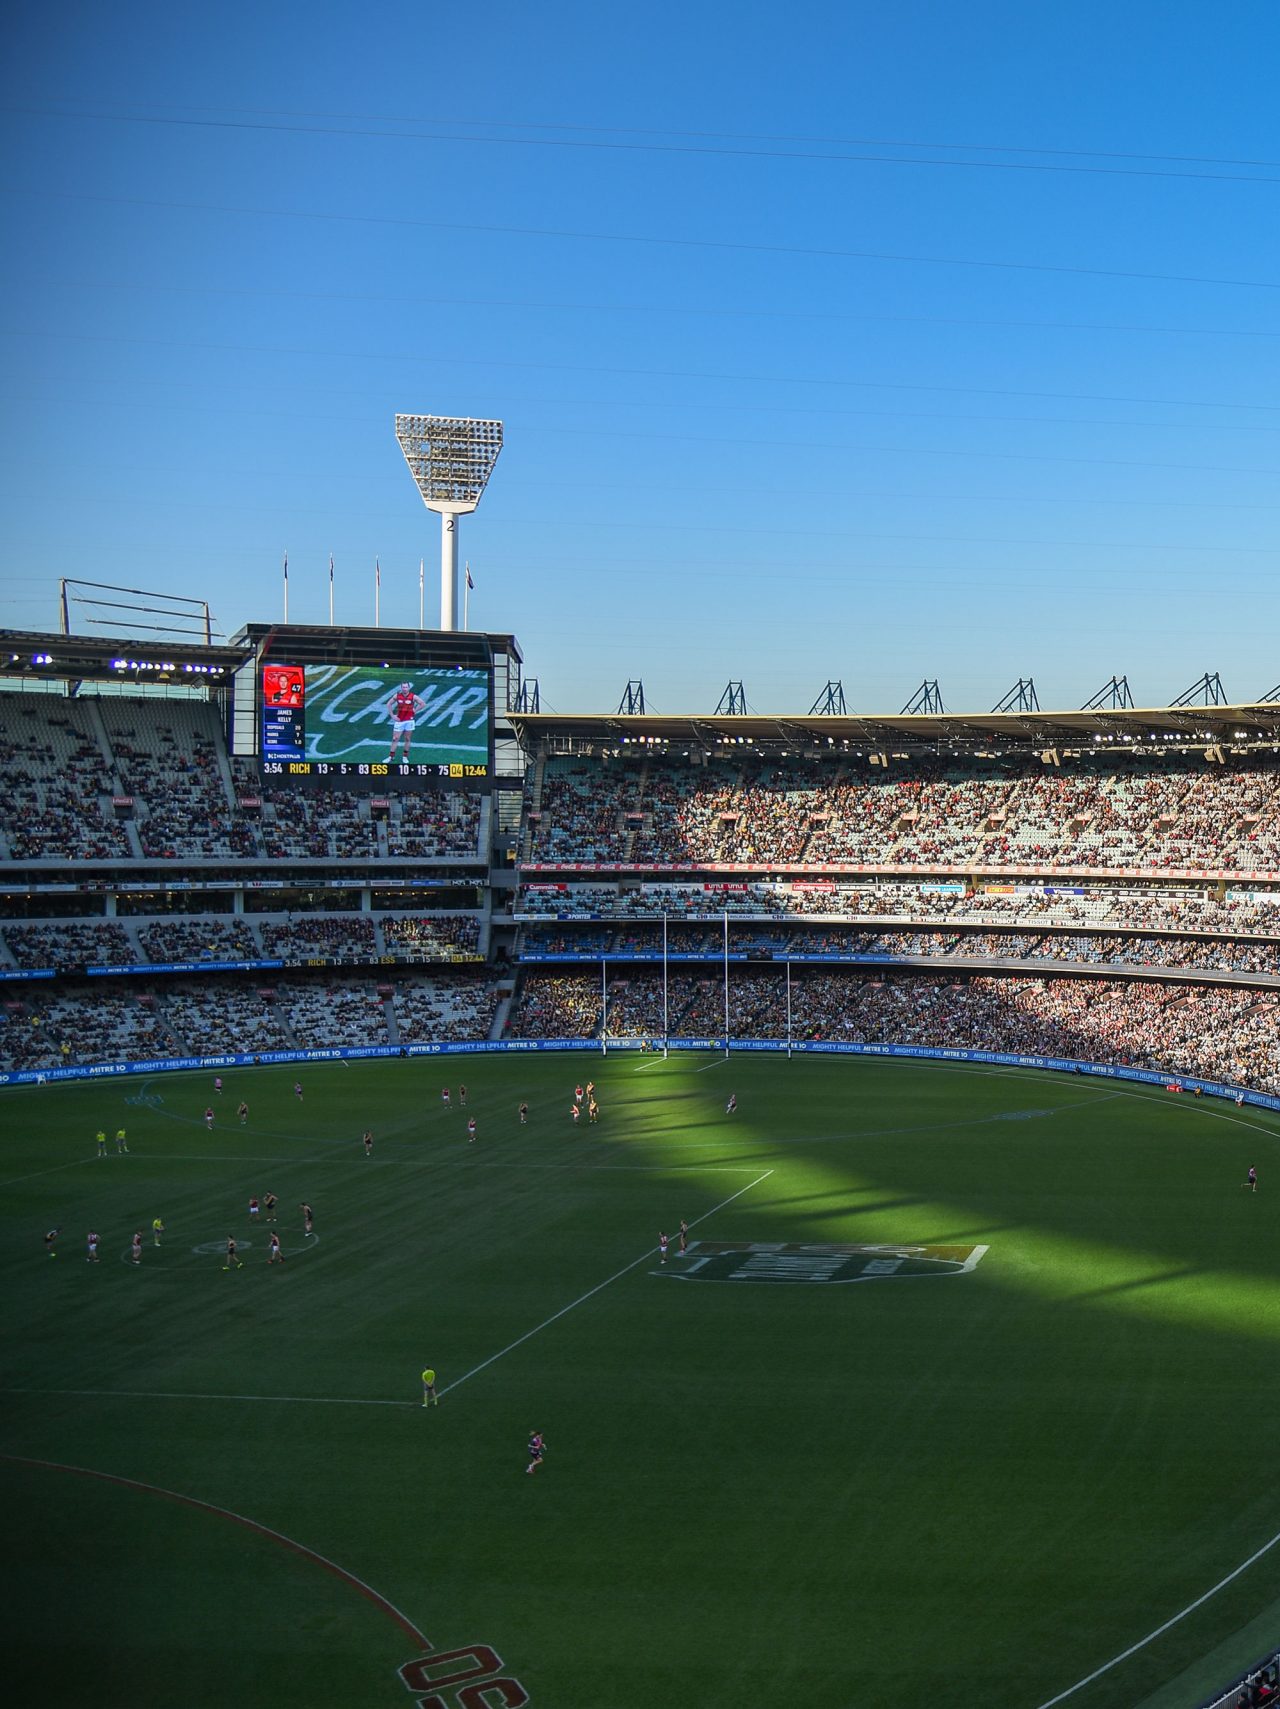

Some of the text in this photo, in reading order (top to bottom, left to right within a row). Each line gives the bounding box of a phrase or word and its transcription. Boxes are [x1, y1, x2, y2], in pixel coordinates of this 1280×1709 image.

[446, 520, 455, 532] 2
[291, 684, 301, 692] 47
[264, 763, 283, 774] 3:54
[289, 763, 311, 774] RICH
[318, 764, 328, 774] 13
[341, 764, 347, 774] 5
[358, 764, 369, 775] 83
[371, 764, 388, 775] ESS
[399, 765, 409, 775] 10
[417, 765, 427, 775] 15
[438, 765, 449, 776] 75
[465, 766, 487, 776] 12:44
[275, 1051, 306, 1060] HELPFUL
[307, 1050, 330, 1058] MITRE
[347, 1048, 375, 1056] MIGHTY
[973, 1052, 995, 1060] MIGHTY
[1019, 1056, 1036, 1064] MITRE
[133, 1062, 163, 1070] MIGHTY
[166, 1059, 198, 1068] HELPFUL
[1048, 1060, 1068, 1068] MIGHTY
[1091, 1065, 1107, 1073] MITRE
[53, 1069, 87, 1077] HELPFUL
[89, 1065, 115, 1073] MITRE
[1119, 1068, 1138, 1077] MIGHTY
[1160, 1075, 1175, 1084] MITRE
